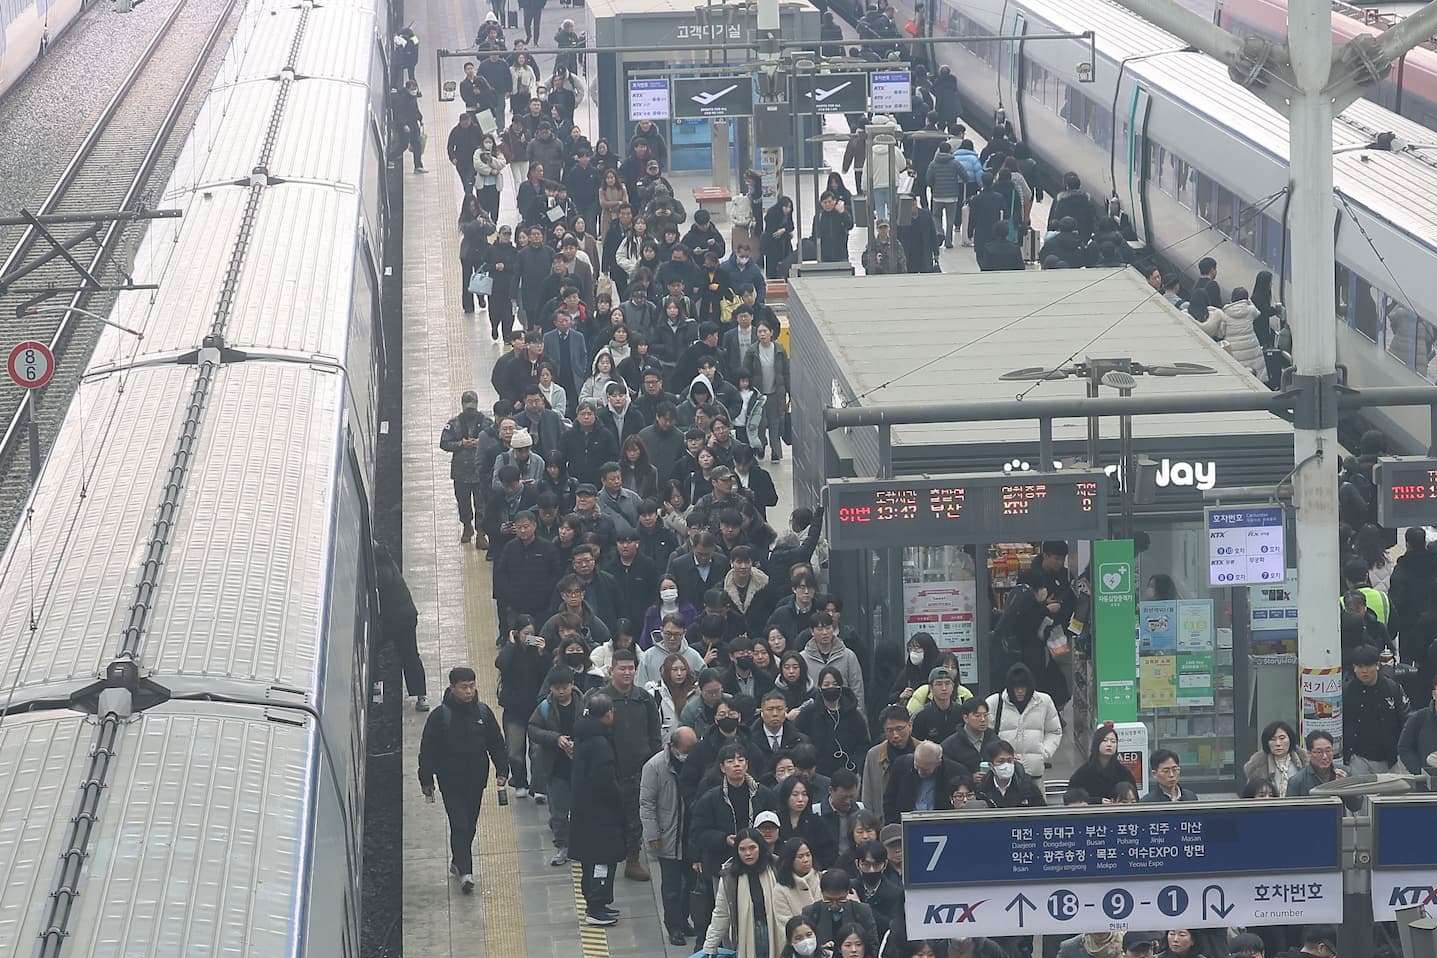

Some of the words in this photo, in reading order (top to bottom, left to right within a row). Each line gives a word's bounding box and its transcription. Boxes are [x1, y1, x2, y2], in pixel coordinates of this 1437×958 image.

[25, 349, 35, 364] 8
[26, 366, 36, 380] 6
[1116, 752, 1138, 762] AED
[1011, 828, 1033, 841] 대전
[1043, 826, 1075, 840] 동대구
[1085, 825, 1107, 838] 부산
[1117, 824, 1139, 837] 포항
[1149, 822, 1170, 835] 진주
[1180, 821, 1202, 834] 마산
[923, 835, 948, 872] 7
[1011, 851, 1033, 864] 익산
[1043, 850, 1086, 863] 광주송정
[1096, 848, 1118, 860] 목포
[1128, 846, 1179, 859] 여수EXPO
[1183, 844, 1205, 857] 방면
[1049, 894, 1079, 916] 18
[1112, 893, 1125, 914] 9
[1167, 889, 1178, 912] 1
[1254, 882, 1324, 903] 호차번호
[923, 900, 984, 925] KTX
[1254, 910, 1269, 918] Car
[1270, 909, 1304, 918] number
